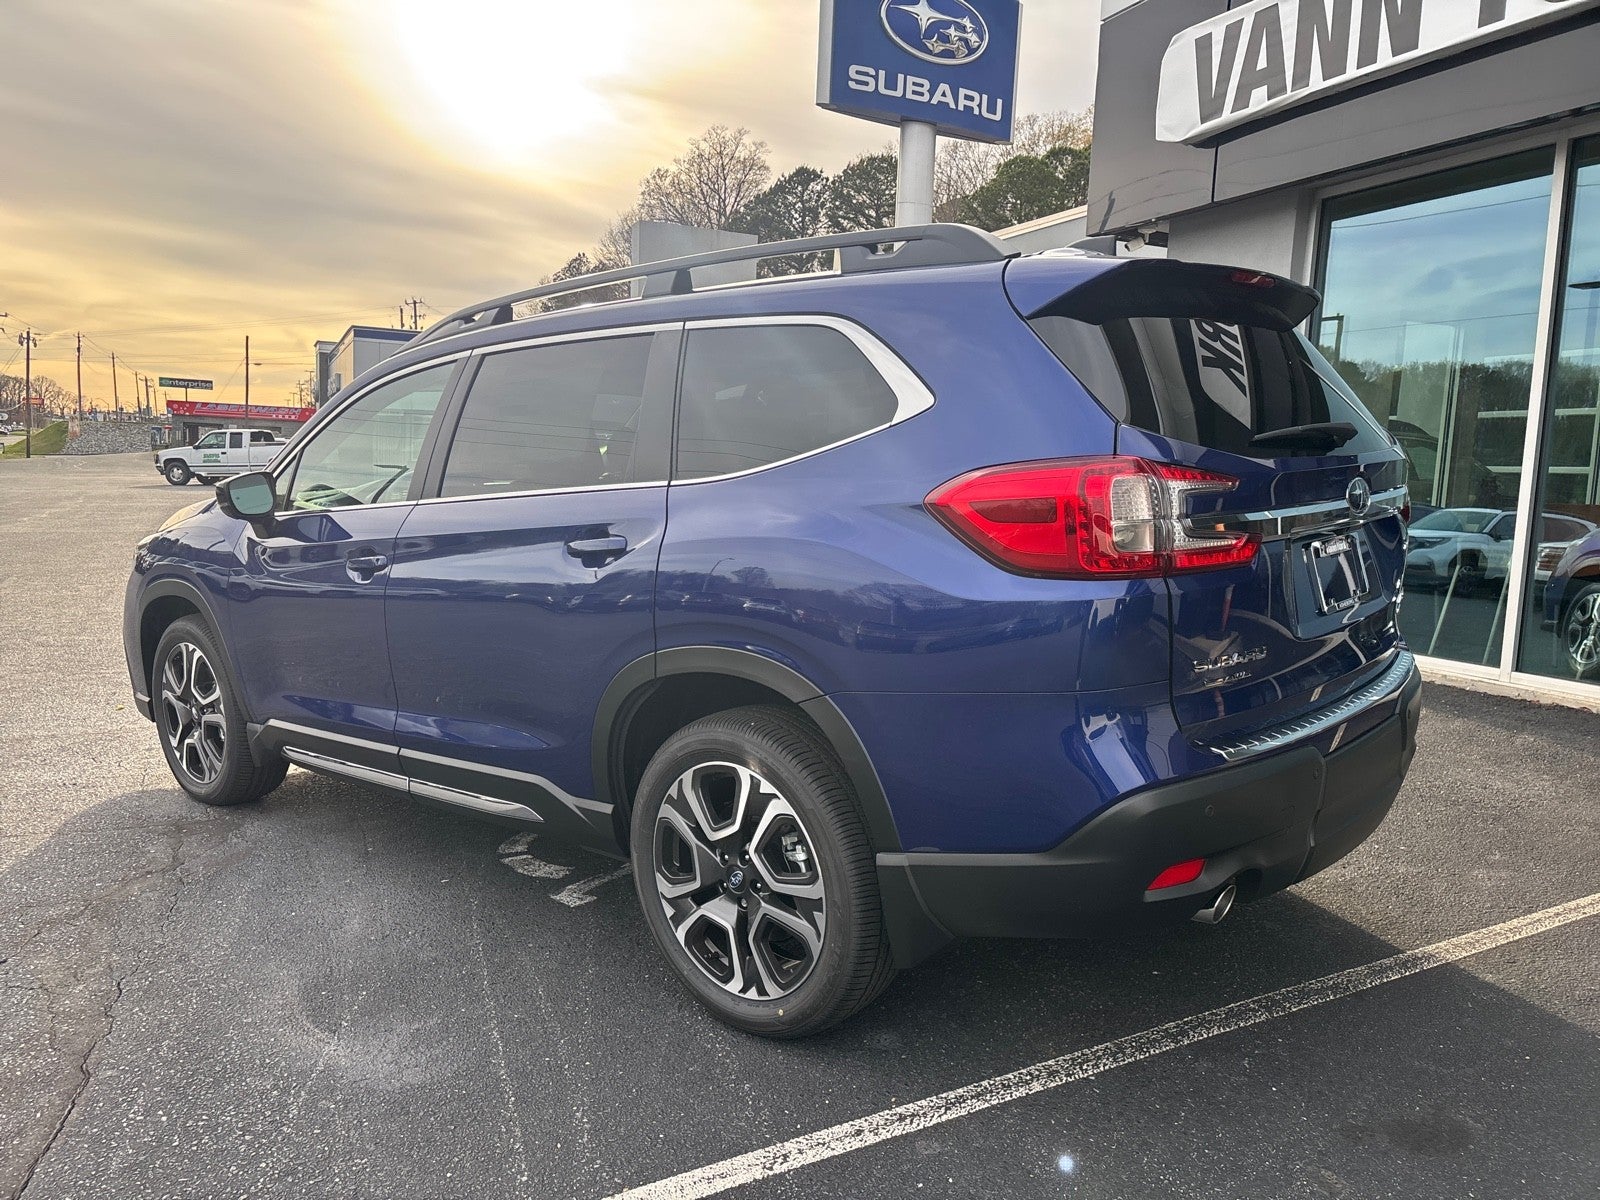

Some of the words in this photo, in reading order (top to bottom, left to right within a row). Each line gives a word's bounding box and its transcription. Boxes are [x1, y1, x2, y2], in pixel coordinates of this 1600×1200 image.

[1194, 0, 1424, 126] VANN
[847, 64, 1003, 121] SUBARU
[161, 379, 213, 389] enterprise
